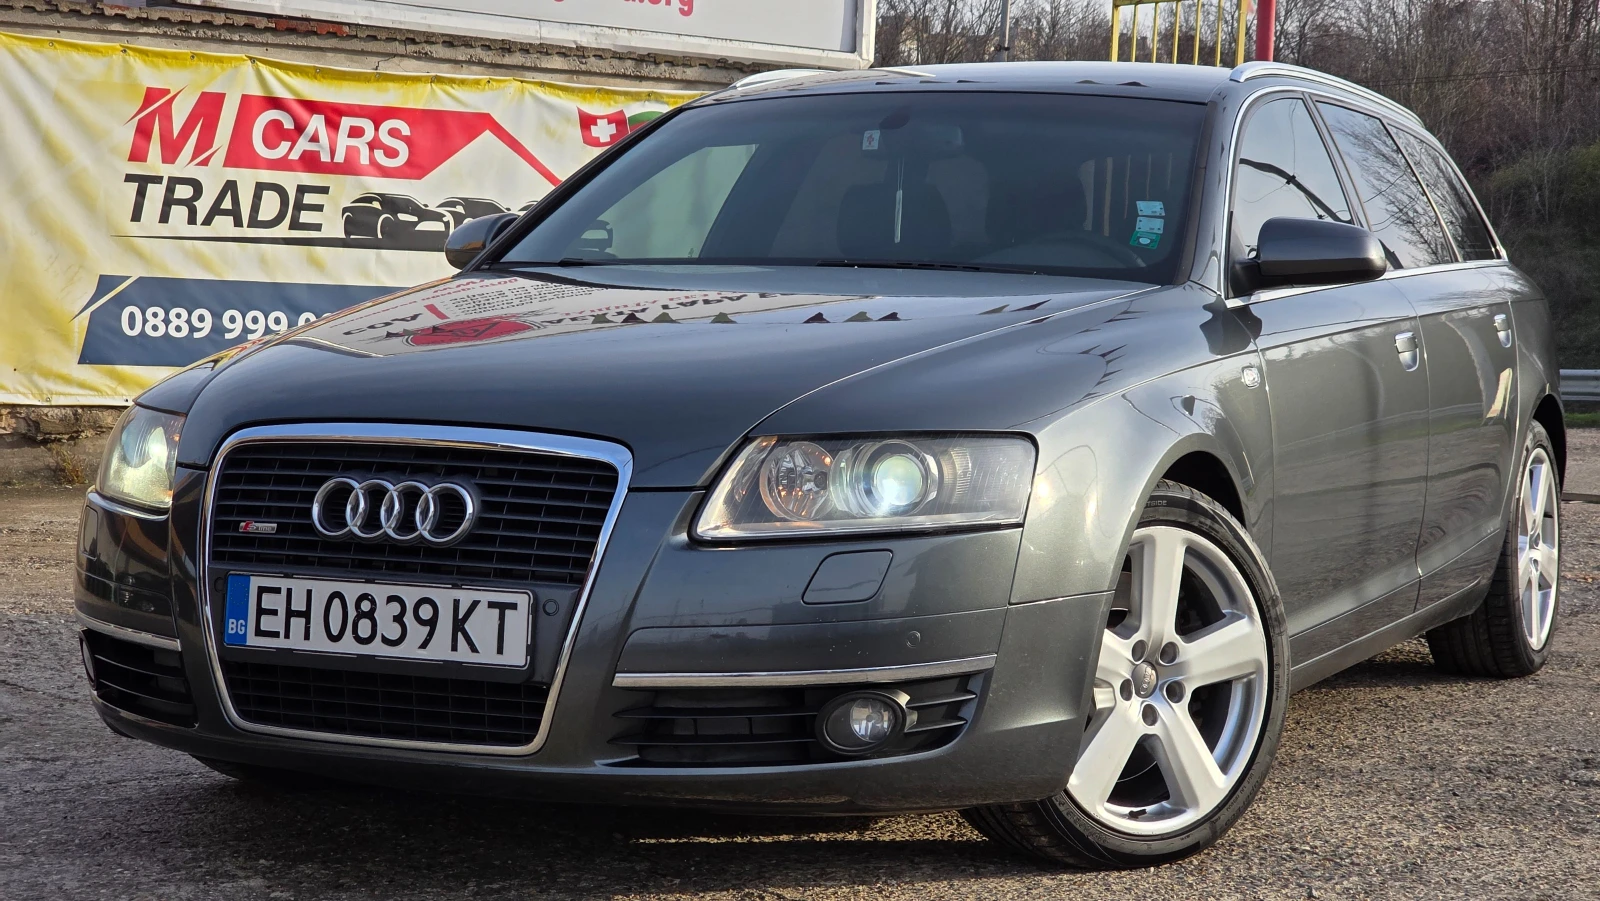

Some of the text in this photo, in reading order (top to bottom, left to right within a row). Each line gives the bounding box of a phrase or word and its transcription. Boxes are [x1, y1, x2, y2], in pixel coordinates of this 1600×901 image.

[123, 85, 411, 168] M CARS
[124, 173, 331, 232] TRADE
[121, 306, 213, 339] 0889
[222, 309, 289, 340] 999
[228, 618, 246, 634] BG
[254, 586, 518, 655] EH 0839 KT
